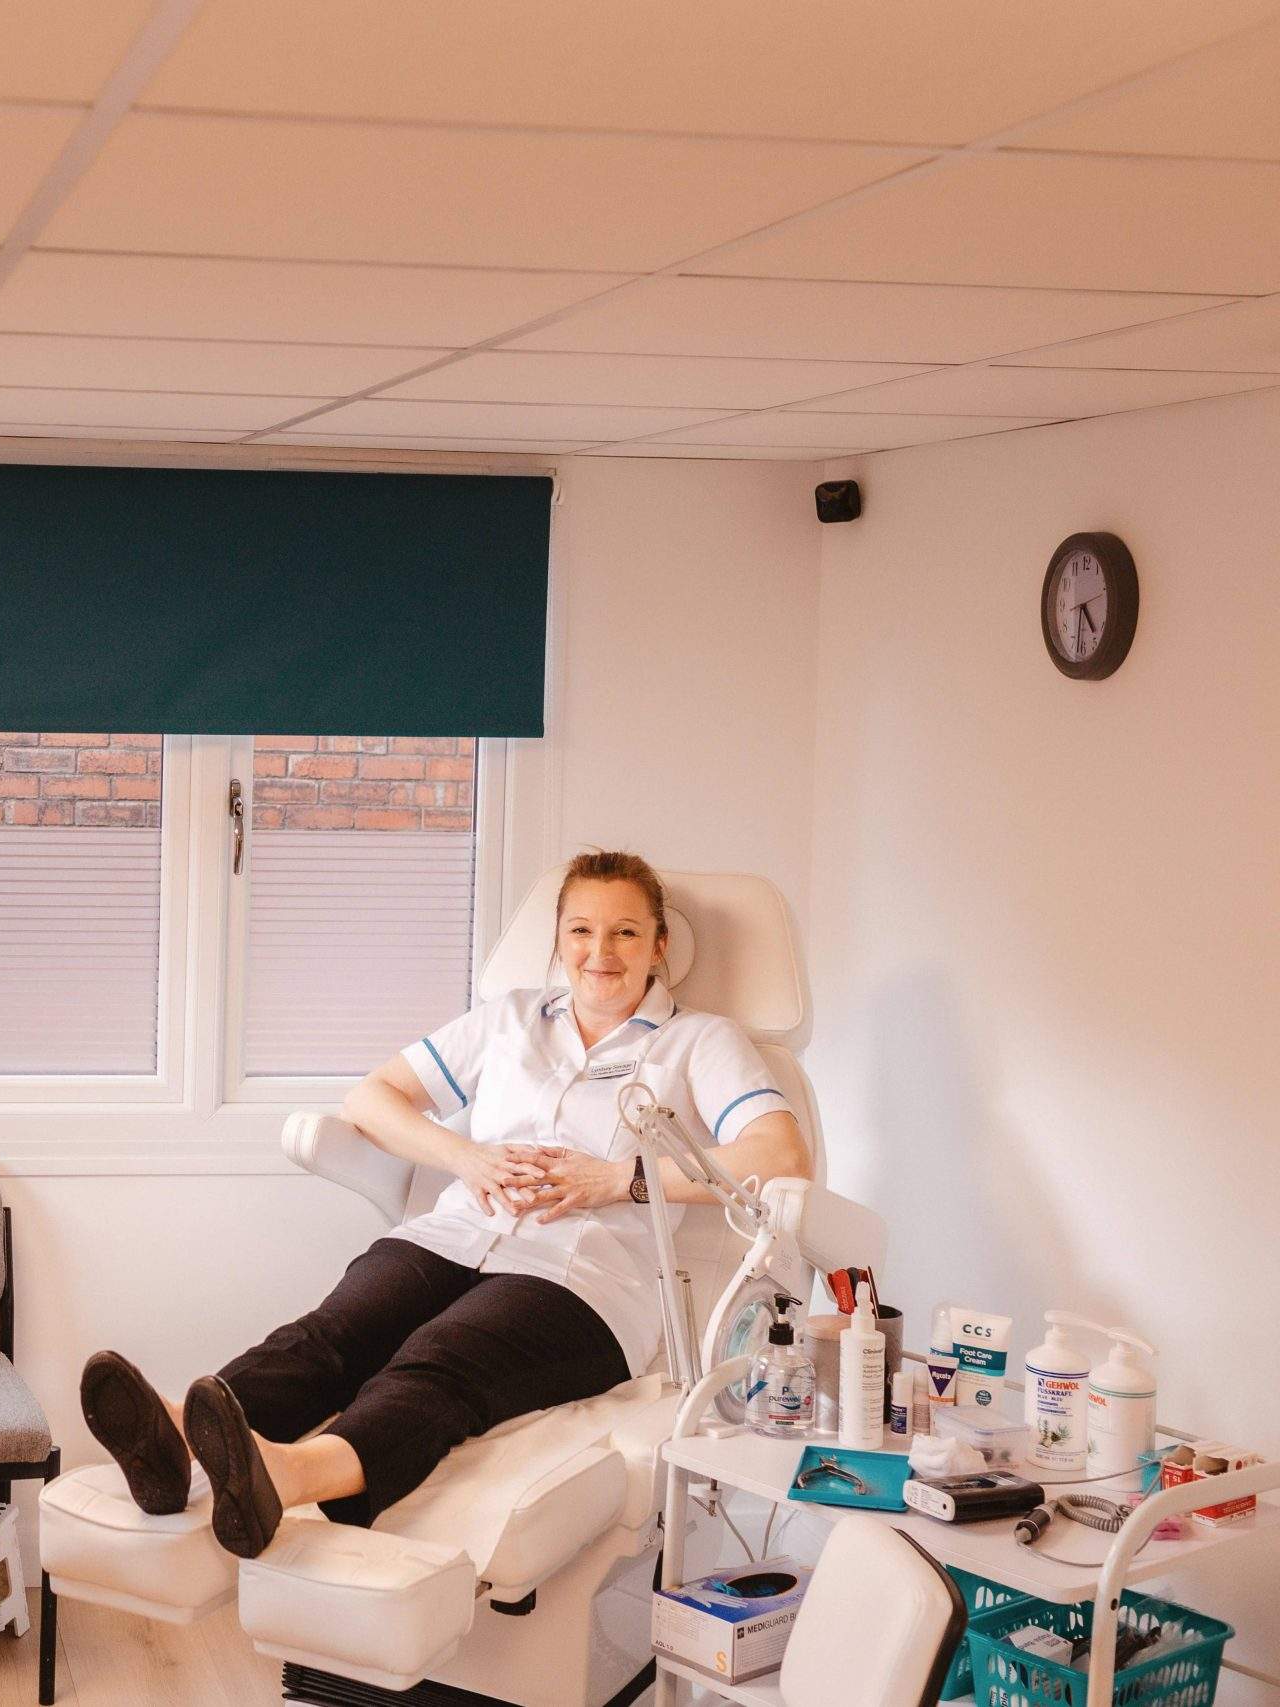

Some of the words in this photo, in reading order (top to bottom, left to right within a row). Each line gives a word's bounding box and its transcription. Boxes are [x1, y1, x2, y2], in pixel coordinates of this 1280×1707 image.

[1072, 562, 1079, 577] 11
[1083, 556, 1091, 571] 12
[960, 1348, 976, 1357] Foot
[977, 1350, 992, 1360] Care
[964, 1356, 987, 1366] Cream
[1045, 1380, 1080, 1390] GEHWOL
[1038, 1388, 1073, 1397] FUSSKRAFT
[747, 1614, 788, 1634] MEDIGUARD
[655, 1640, 666, 1650] AQL
[714, 1651, 727, 1673] S
